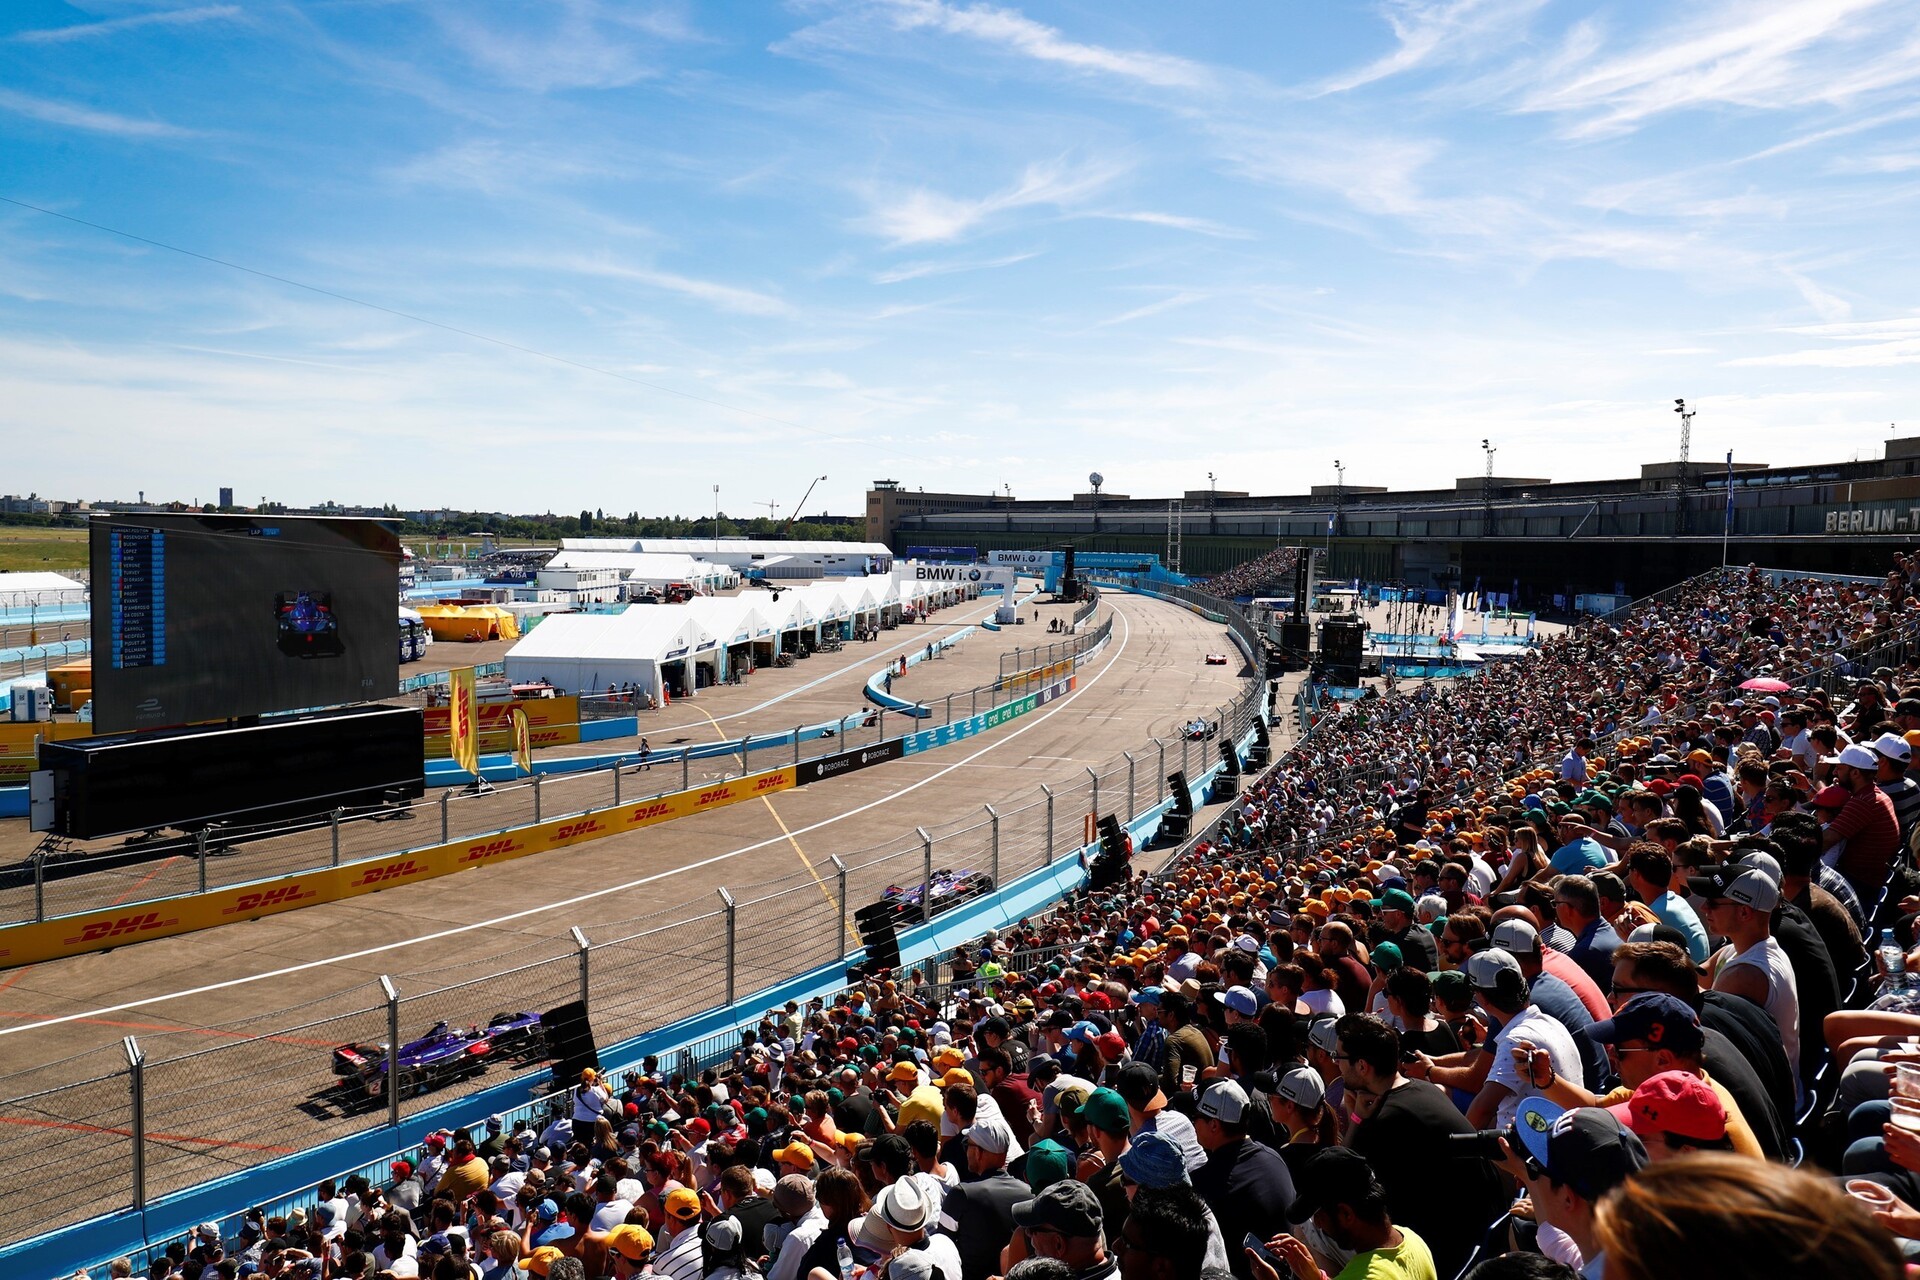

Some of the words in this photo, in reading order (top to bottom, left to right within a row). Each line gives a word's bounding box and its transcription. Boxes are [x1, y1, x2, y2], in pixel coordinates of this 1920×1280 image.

[916, 568, 954, 580] BMW
[362, 679, 374, 687] FIA
[458, 686, 468, 738] DHL
[988, 710, 998, 726] enel
[1002, 706, 1012, 720] enel
[1015, 701, 1024, 715] enel
[1027, 696, 1036, 710] enel
[530, 732, 560, 742] DHL
[824, 758, 849, 772] ROBORACE
[868, 747, 890, 760] ROBORACE
[758, 774, 784, 790] DHL
[700, 788, 730, 805] DHL
[633, 803, 668, 821] DHL
[558, 820, 599, 840] DHL
[468, 839, 516, 861] DHL
[362, 860, 418, 885] DHL
[236, 884, 304, 912] DHL
[80, 913, 165, 941] DHL
[1648, 1022, 1665, 1042] 3
[372, 1082, 379, 1092] 2
